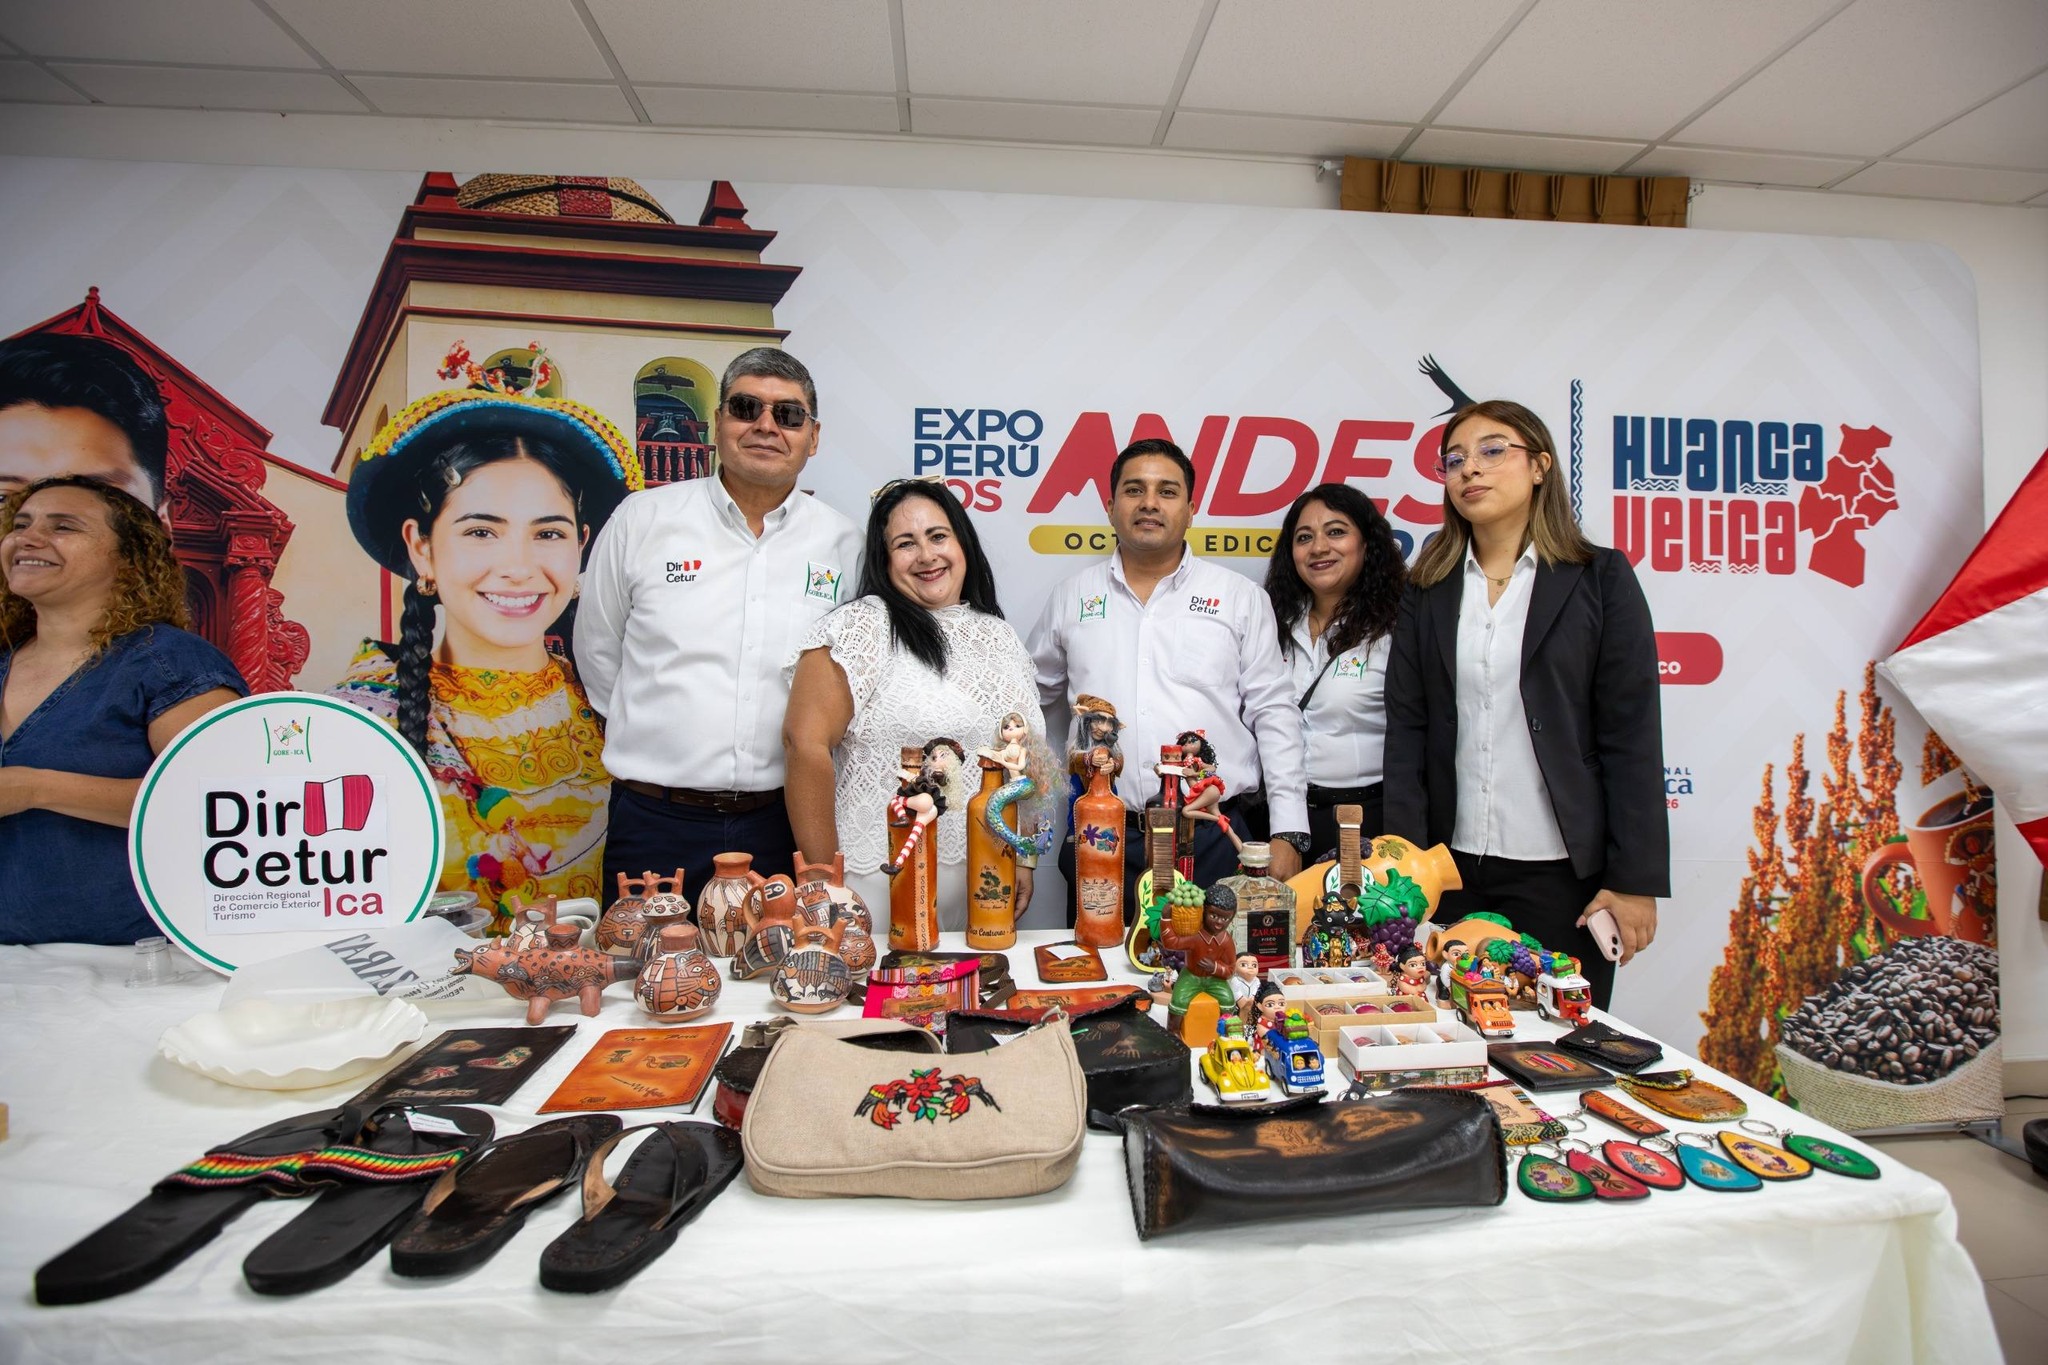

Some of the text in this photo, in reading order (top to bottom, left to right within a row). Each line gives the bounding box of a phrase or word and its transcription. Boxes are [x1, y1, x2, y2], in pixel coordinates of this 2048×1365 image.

[914, 407, 1044, 442] EXPO
[913, 442, 1040, 478] PERÚ
[945, 478, 1003, 512] OS
[1205, 535, 1278, 552] EDIC
[666, 561, 683, 572] Dir
[666, 573, 697, 583] Cetur
[1190, 595, 1208, 606] Dir
[1189, 603, 1220, 615] Cetur
[205, 789, 301, 838] Dir
[203, 839, 388, 889] Cetur
[213, 890, 311, 903] Dirección Regional
[323, 887, 384, 918] Ica
[213, 900, 321, 912] de Comercio Exterior
[213, 912, 256, 921] Turismo
